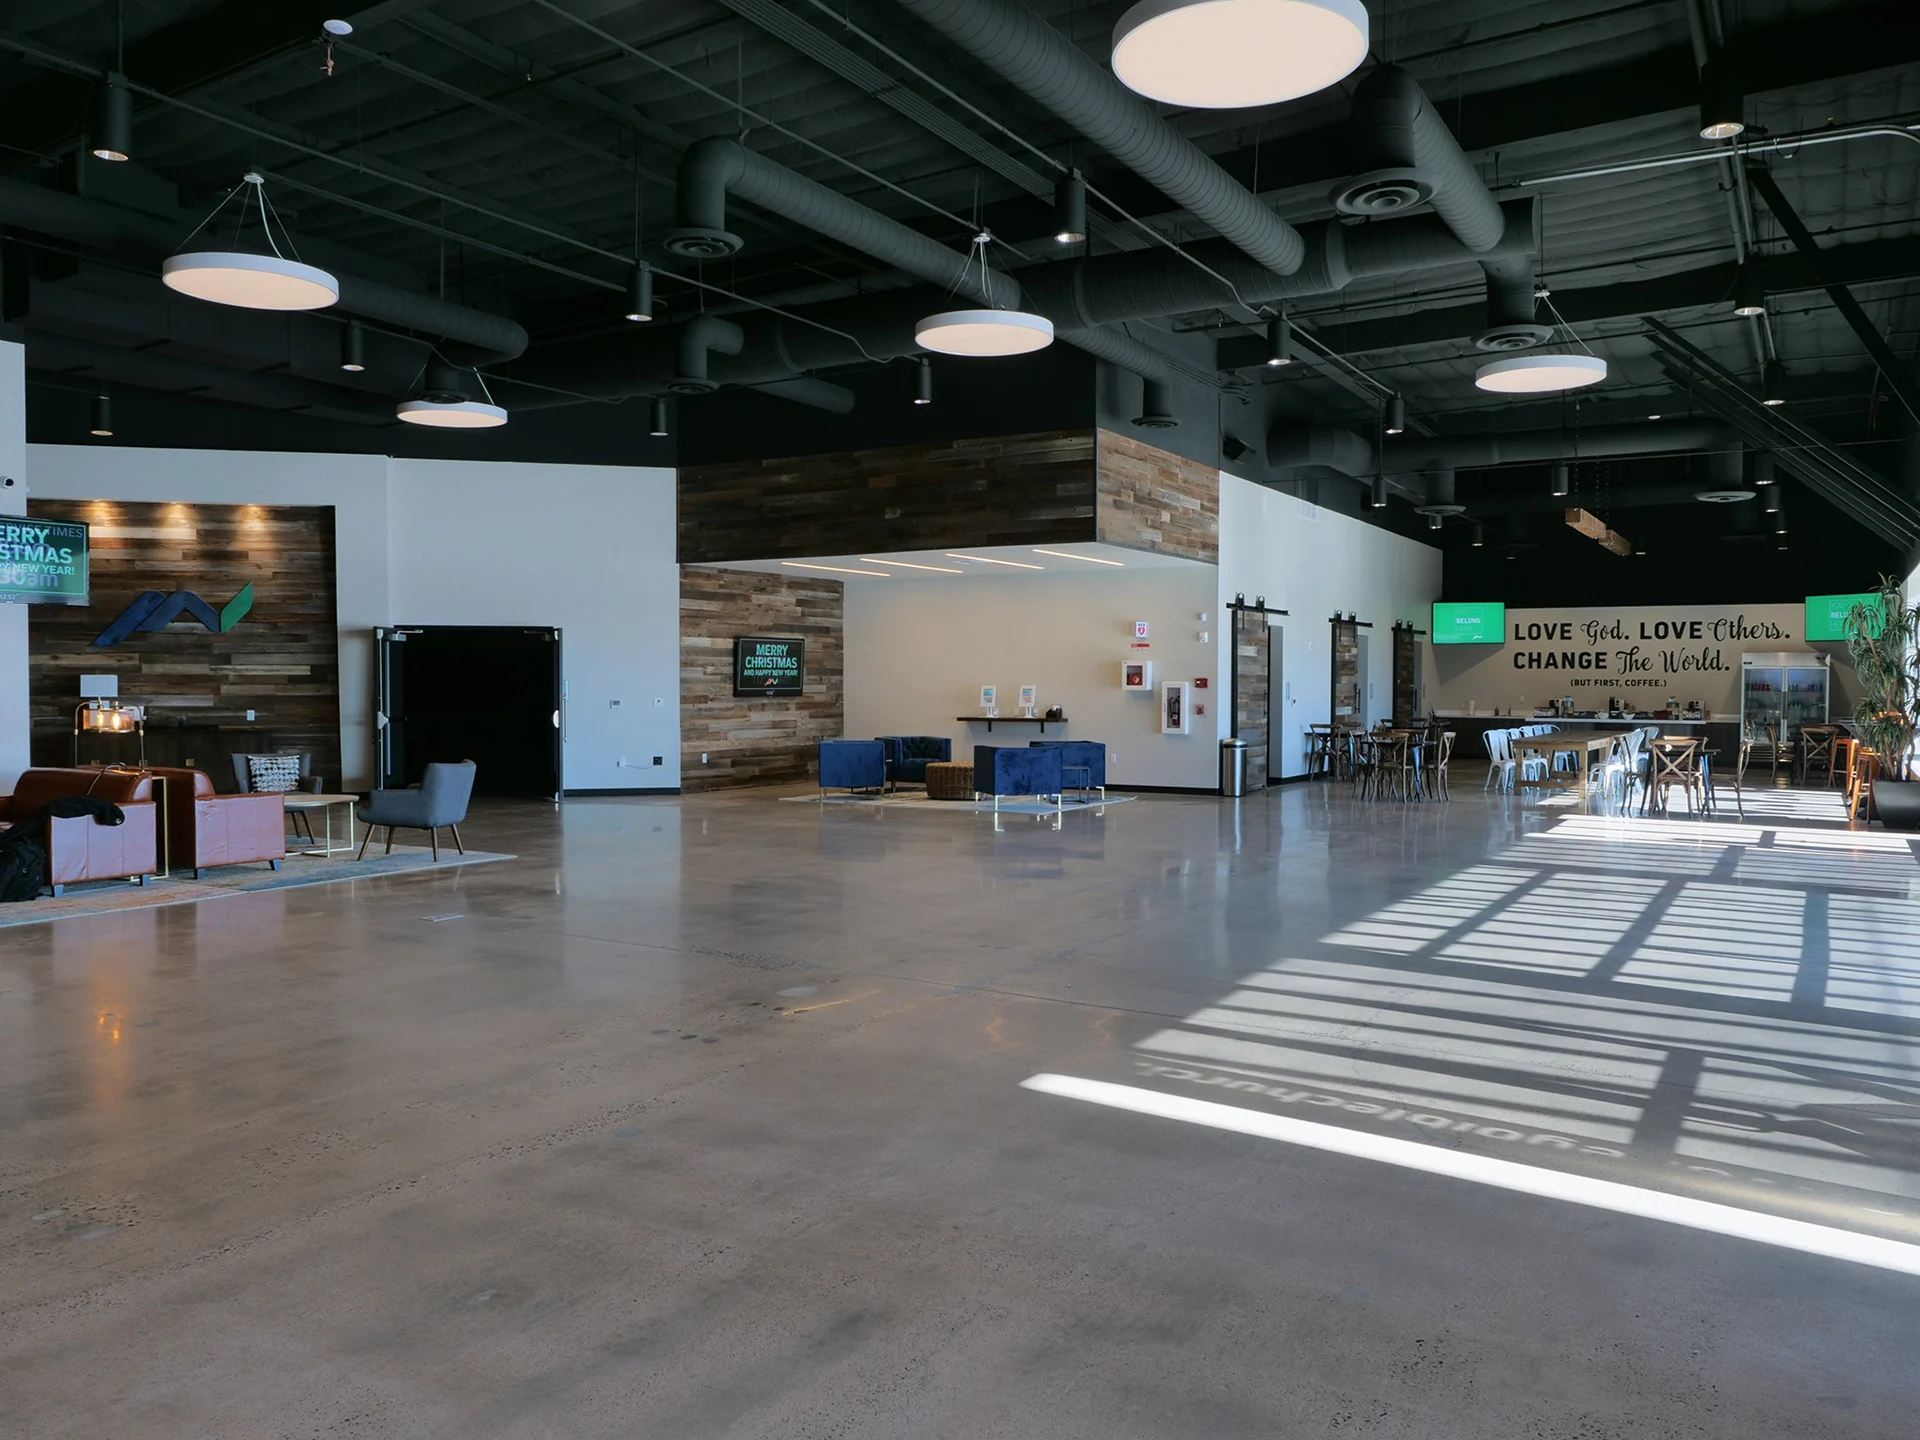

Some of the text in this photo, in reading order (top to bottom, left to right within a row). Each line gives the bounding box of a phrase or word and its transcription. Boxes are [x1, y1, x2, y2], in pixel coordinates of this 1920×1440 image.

[42, 564, 75, 576] YEAR!
[1456, 617, 1482, 625] BELONG
[1514, 614, 1791, 646] LOVE God. LOVE Others.
[756, 644, 789, 656] MERRY
[745, 656, 798, 668] CHRISTMAS
[1513, 645, 1730, 675] CHANGE The World.
[1570, 678, 1667, 688] (BUT FIRST, COFFEE.)
